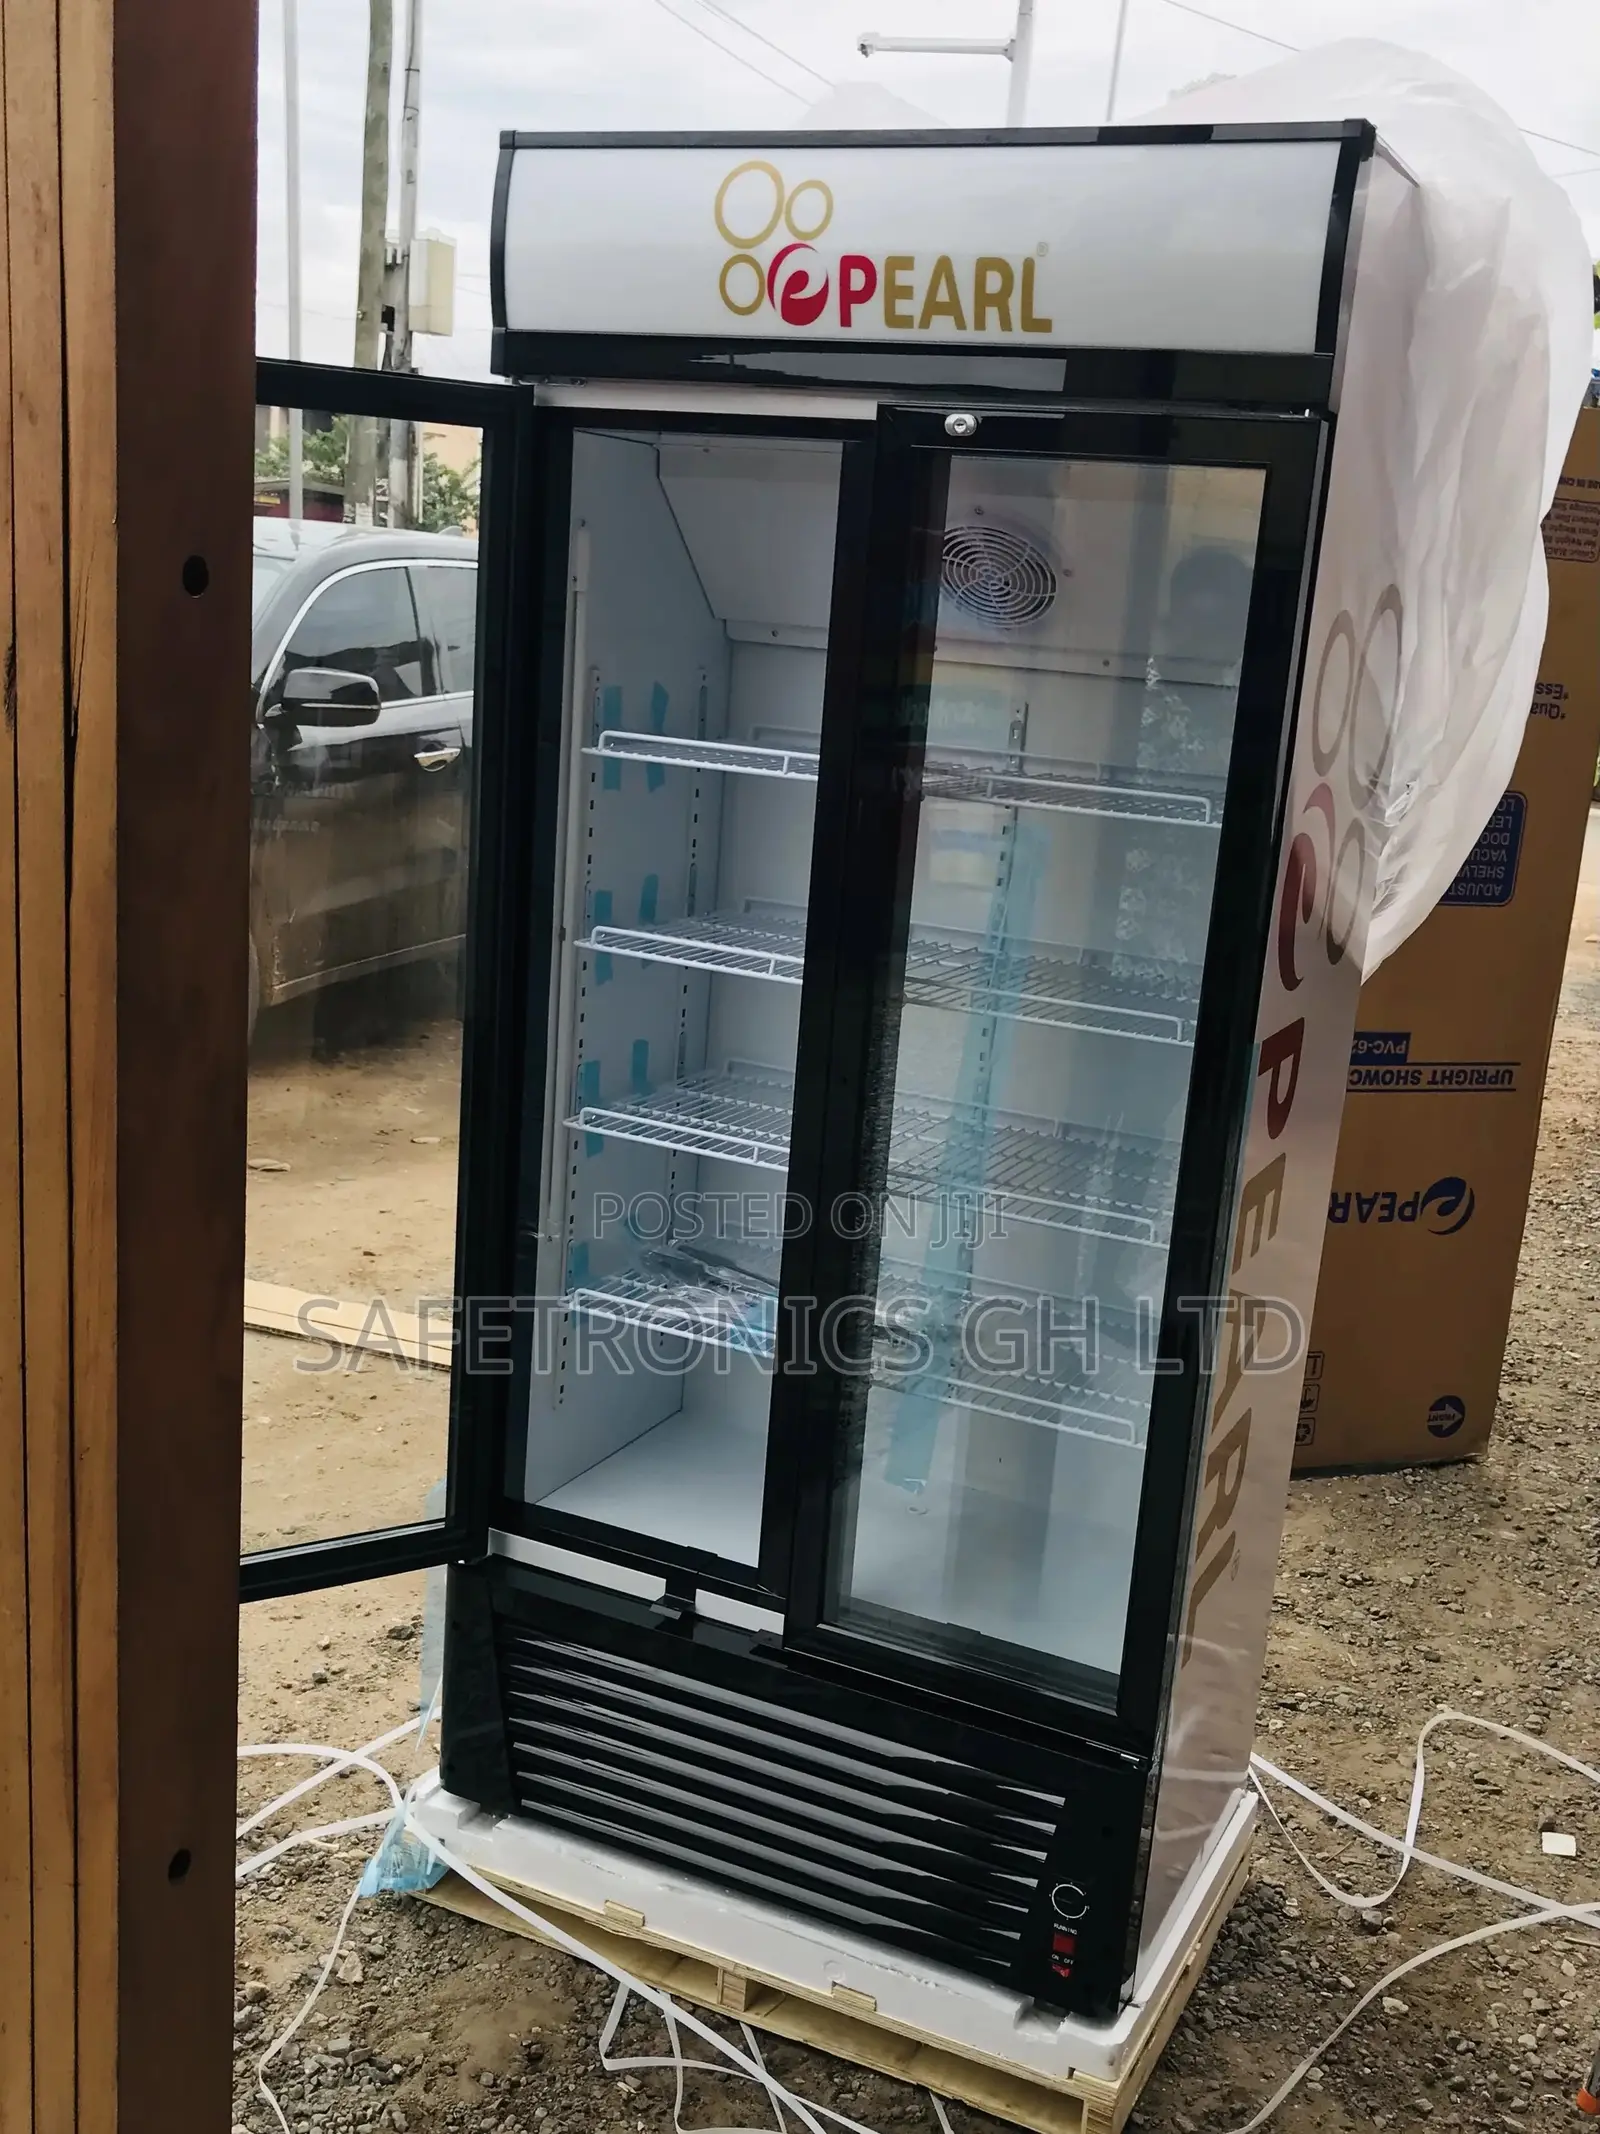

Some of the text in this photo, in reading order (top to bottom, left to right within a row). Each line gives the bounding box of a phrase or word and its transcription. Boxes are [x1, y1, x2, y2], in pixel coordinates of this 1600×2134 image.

[839, 254, 1053, 334] PEARL
[1349, 1069, 1514, 1086] UPRIGHT SHOWC
